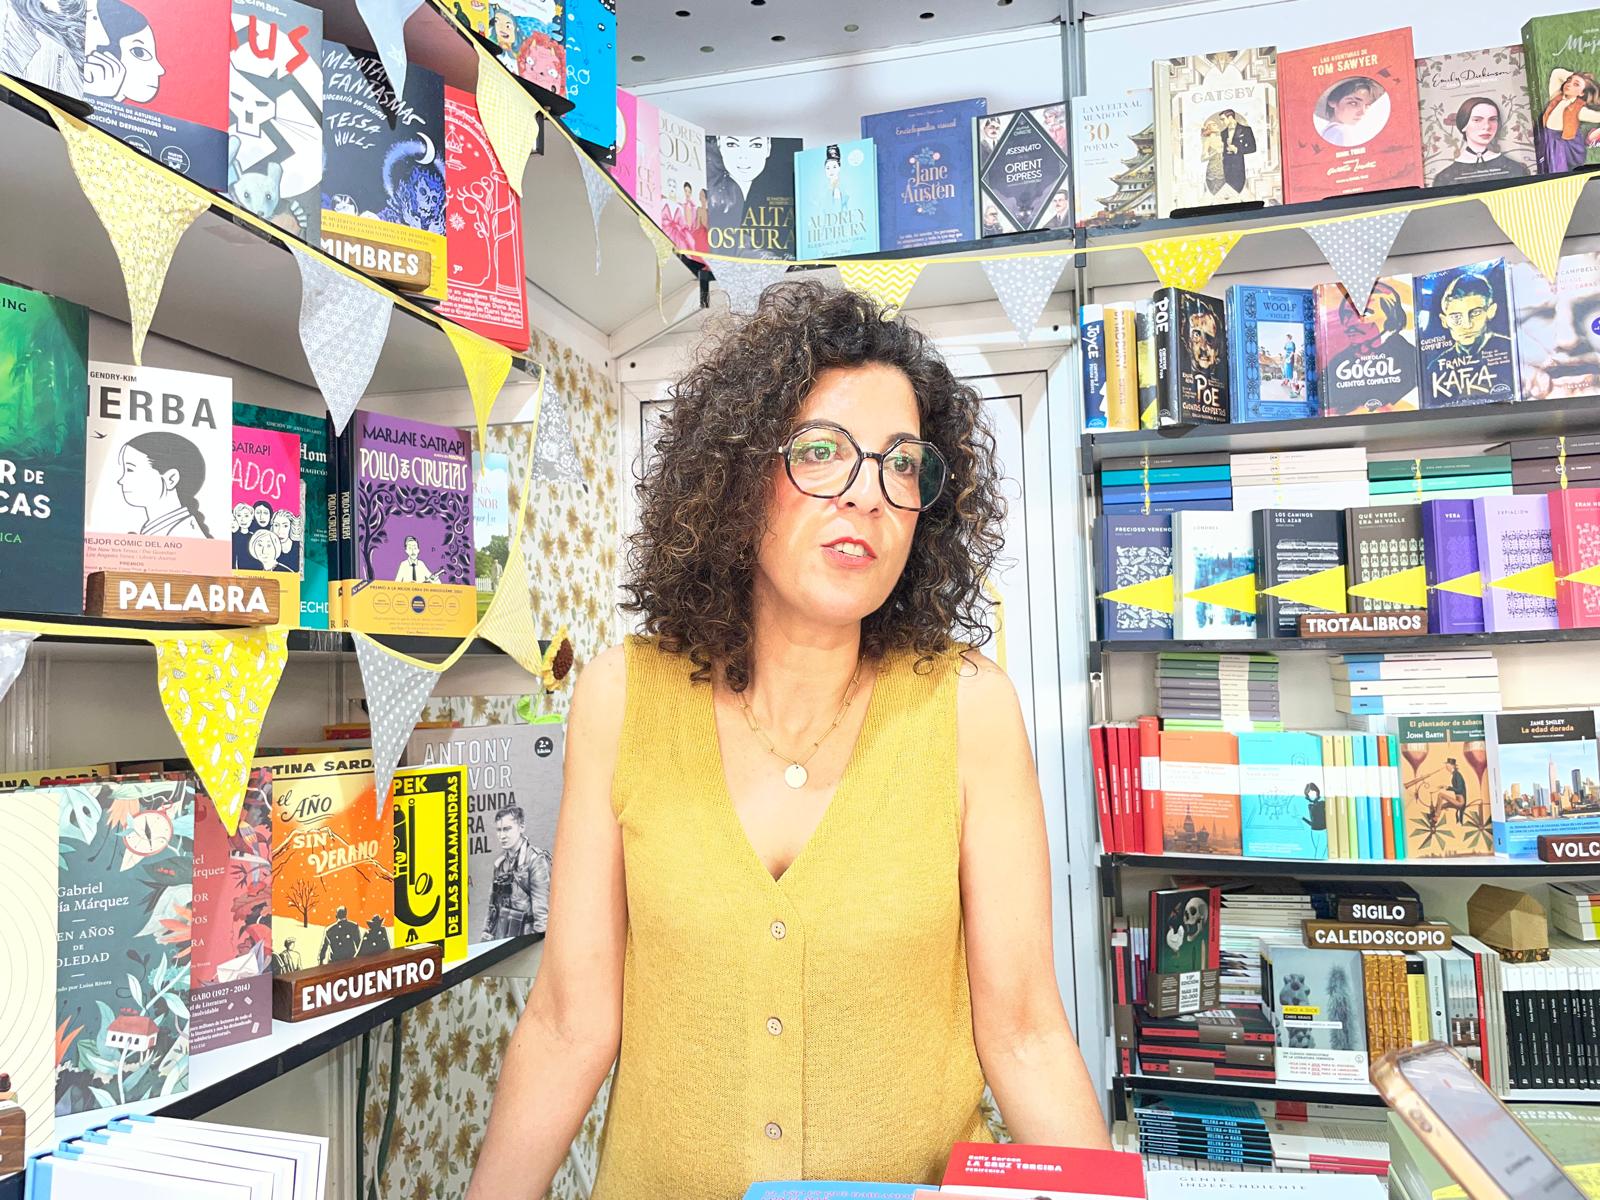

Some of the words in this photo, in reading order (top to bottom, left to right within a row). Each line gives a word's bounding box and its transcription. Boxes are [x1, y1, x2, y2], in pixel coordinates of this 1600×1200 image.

[1312, 64, 1334, 76] TOM
[1338, 54, 1378, 72] SAWYER
[1463, 66, 1511, 82] Dickinson
[328, 73, 426, 126] FANTASMAS
[1192, 86, 1256, 104] GATSBY
[97, 101, 124, 112] PRINCESA
[134, 111, 161, 122] ASTURIAS
[119, 112, 161, 128] HUMANIDADES
[119, 122, 158, 137] DEFINITIVA
[326, 112, 381, 134] TESSA
[1084, 122, 1110, 142] 30
[334, 130, 376, 150] HULLS
[1006, 143, 1042, 156] ASESINATO
[909, 161, 948, 187] Jane
[1005, 158, 1042, 174] ORIENT
[1006, 170, 1042, 183] EXPRESS
[901, 183, 955, 204] Austen
[742, 206, 794, 228] ALTA
[810, 208, 864, 229] AUDREY
[708, 227, 795, 250] OSTURA
[808, 224, 867, 244] HEPBURN
[1156, 296, 1170, 335] POE
[1263, 302, 1297, 312] WOOLF
[1336, 357, 1402, 381] GÓGOL
[1438, 356, 1480, 370] FRANZ
[90, 371, 138, 382] GENDRY-KIM
[1336, 380, 1365, 389] CUENTOS
[1367, 376, 1401, 386] COMPLETOS
[1432, 365, 1498, 398] KAFKA
[1195, 374, 1220, 407] POE
[232, 441, 271, 456] SATRAPI
[363, 424, 418, 448] MARJANE
[420, 434, 466, 457] SATRAPI
[24, 469, 44, 484] DE
[232, 458, 286, 500] ADOS
[360, 448, 400, 482] POLLO
[412, 455, 468, 492] CIRUELAS
[1115, 526, 1146, 534] PRECIOSO
[1148, 526, 1172, 534] VENENO
[119, 581, 270, 613] PALABRA
[1306, 615, 1421, 633] TROTALIBROS
[1410, 720, 1417, 728] El
[1418, 719, 1451, 730] plantador
[1520, 726, 1530, 734] La
[1530, 726, 1548, 734] edad
[1550, 724, 1574, 733] dorada
[1546, 718, 1565, 726] SMILEY
[1406, 731, 1424, 740] JOHN
[1425, 730, 1444, 740] BARTH
[424, 736, 514, 766] ANTONY
[272, 762, 316, 776] TINA
[468, 765, 512, 788] VOR
[394, 776, 428, 796] PEK
[277, 790, 292, 807] el
[468, 792, 516, 813] GUNDA
[280, 794, 332, 822] AÑO
[448, 776, 459, 882] SALAMANDRAS
[292, 832, 328, 850] SIN
[1552, 842, 1600, 858] VOLC
[308, 840, 380, 875] VERANO
[57, 882, 103, 898] Gabriel
[194, 892, 209, 902] OR
[74, 897, 130, 911] Márquez
[448, 888, 459, 914] LAS
[1352, 904, 1406, 920] SIGILO
[57, 931, 74, 942] EN
[80, 926, 114, 940] AÑOS
[448, 915, 459, 935] DE
[1314, 930, 1446, 946] CALEIDOSCOPIO
[73, 944, 84, 952] DE
[57, 952, 110, 968] OLEDAD
[192, 992, 211, 1002] GABO
[212, 988, 229, 998] (1927
[234, 983, 251, 993] 2014)
[302, 958, 435, 1012] ENCUENTRO
[1180, 1182, 1306, 1190] INDEPENDIENTE
